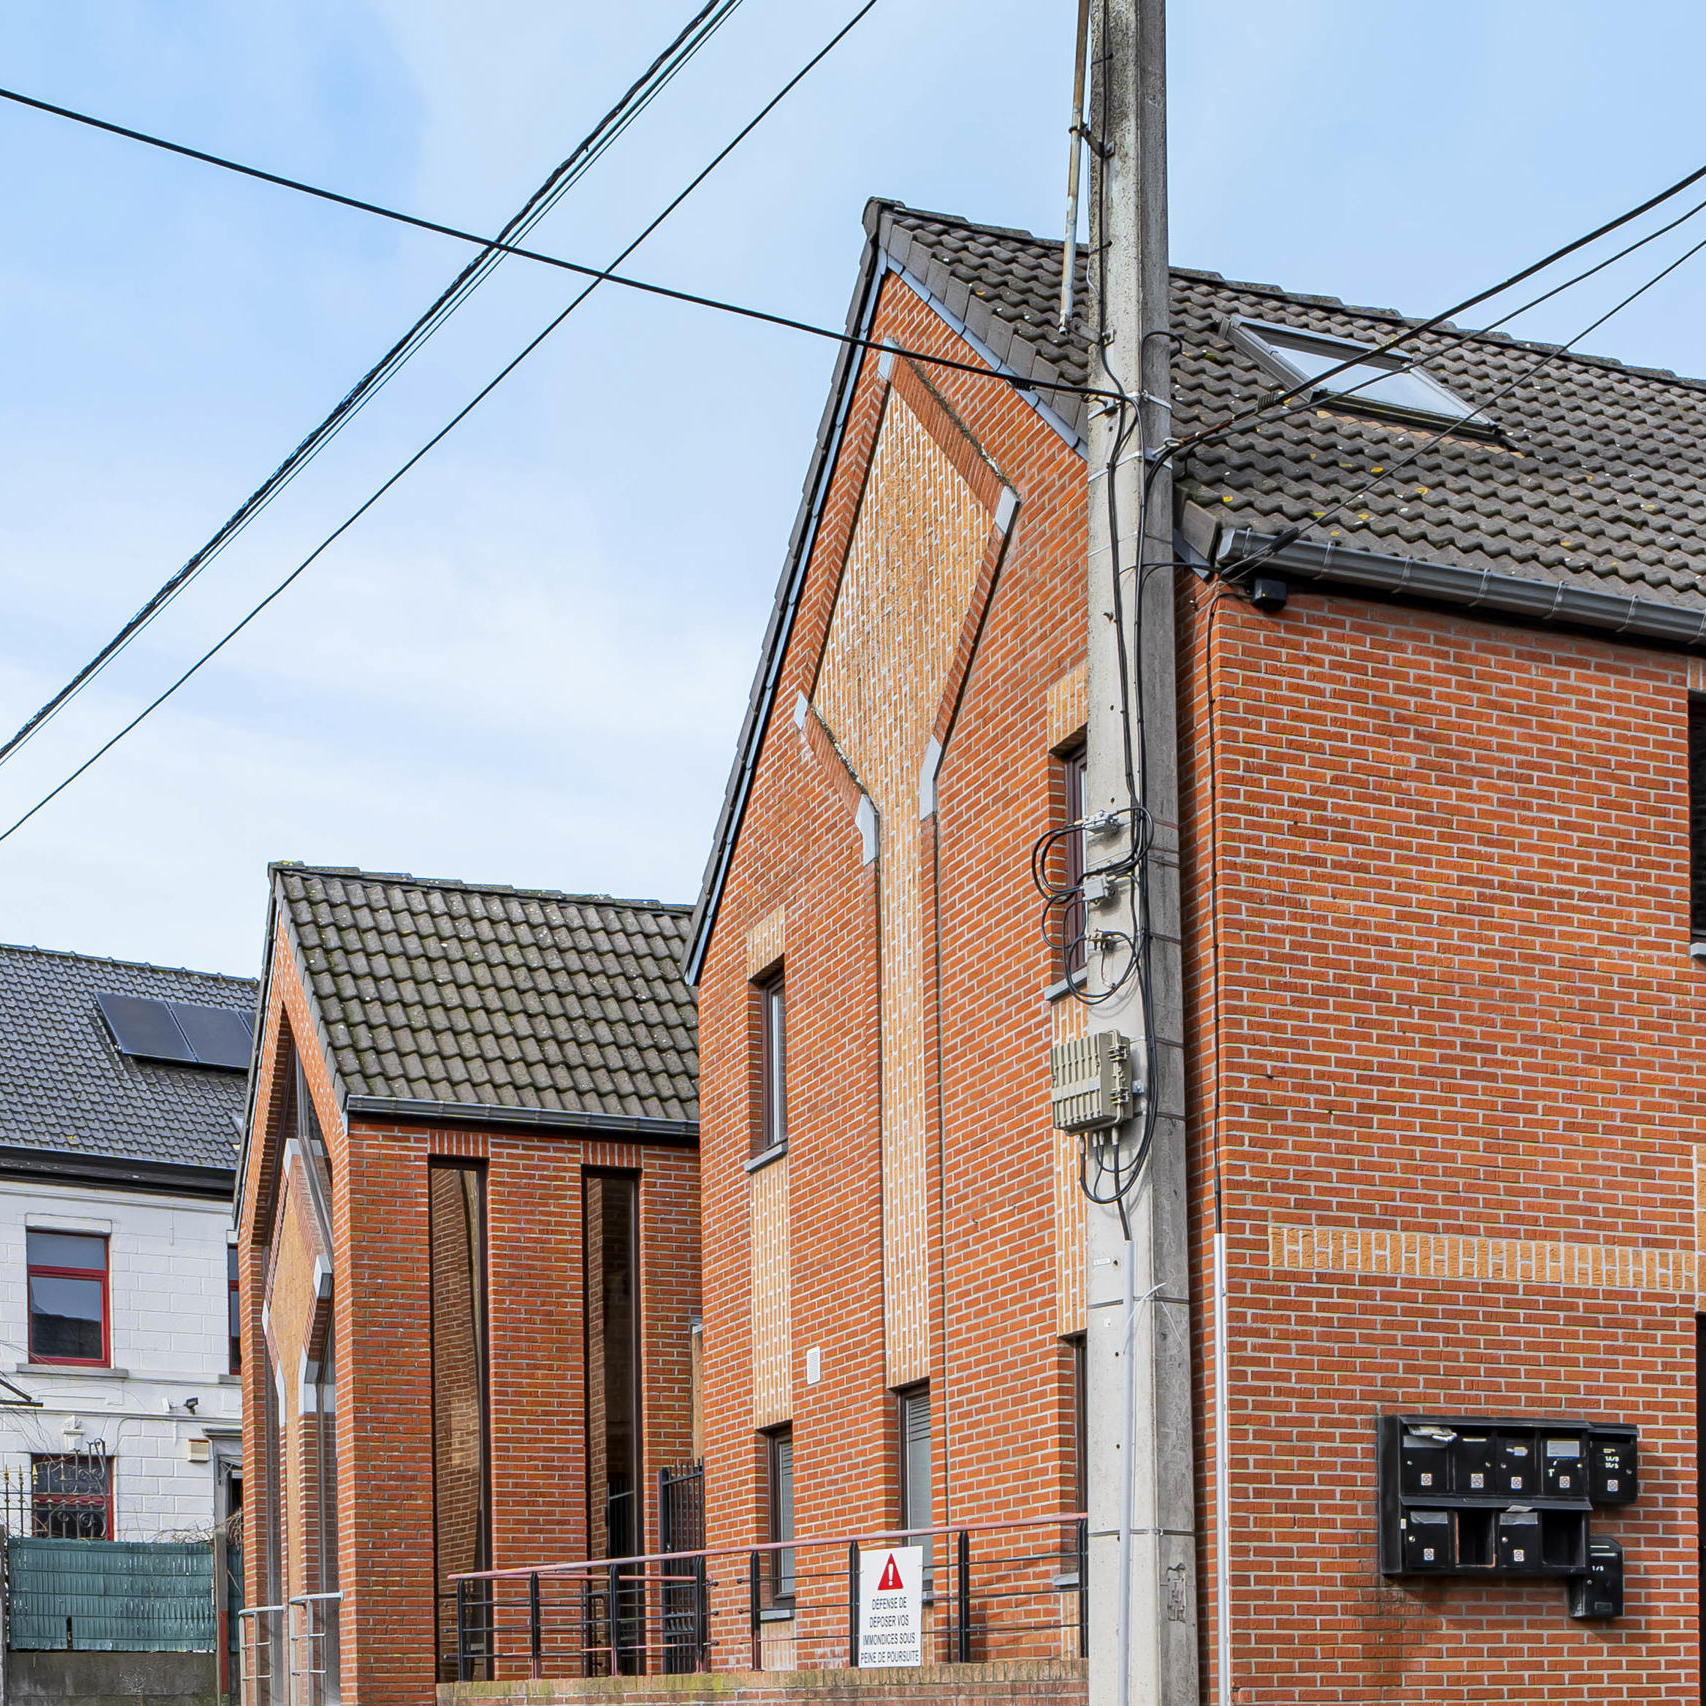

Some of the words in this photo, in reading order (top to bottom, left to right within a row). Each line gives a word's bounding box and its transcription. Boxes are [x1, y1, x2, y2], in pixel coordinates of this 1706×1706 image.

[899, 1597, 907, 1608] DE
[897, 1614, 909, 1626] VOS
[863, 1633, 898, 1645] IMMONDICES
[899, 1632, 915, 1644] SOUS
[861, 1652, 876, 1663] PEINE
[878, 1651, 885, 1663] DE
[887, 1650, 919, 1662] POURSUITE
